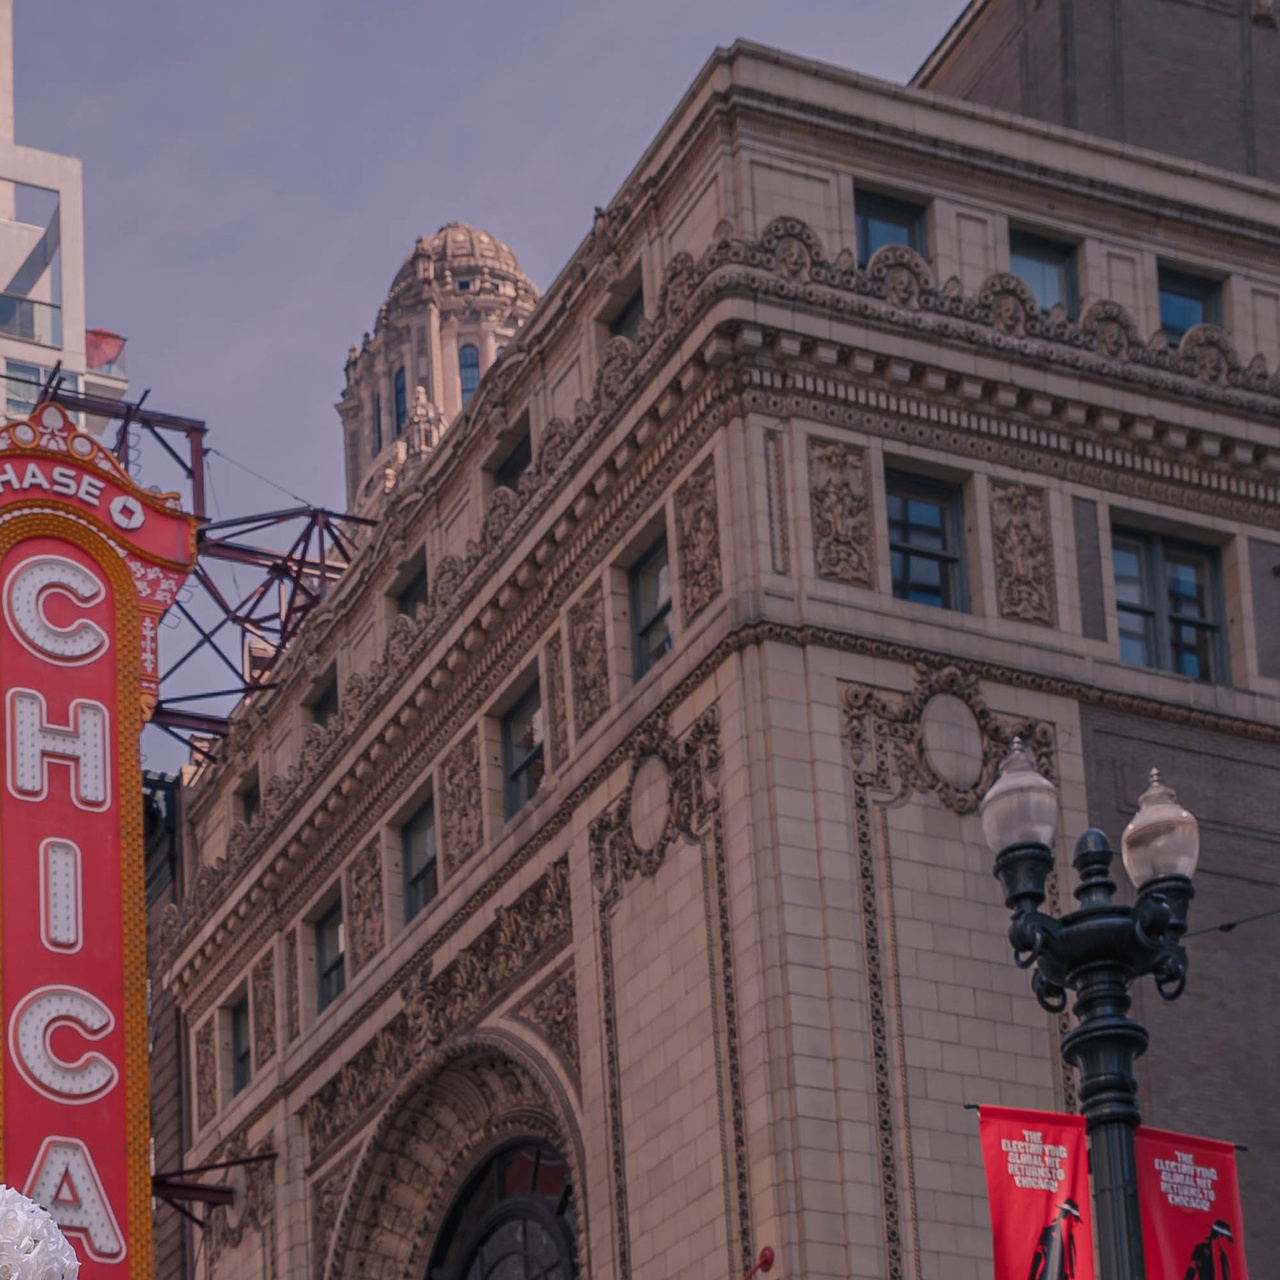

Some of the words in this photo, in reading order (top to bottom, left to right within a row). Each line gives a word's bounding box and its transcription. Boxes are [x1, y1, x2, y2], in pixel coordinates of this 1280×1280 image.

[1022, 1129, 1043, 1144] THE
[1174, 1150, 1194, 1165] THE
[1051, 1169, 1065, 1181] TO
